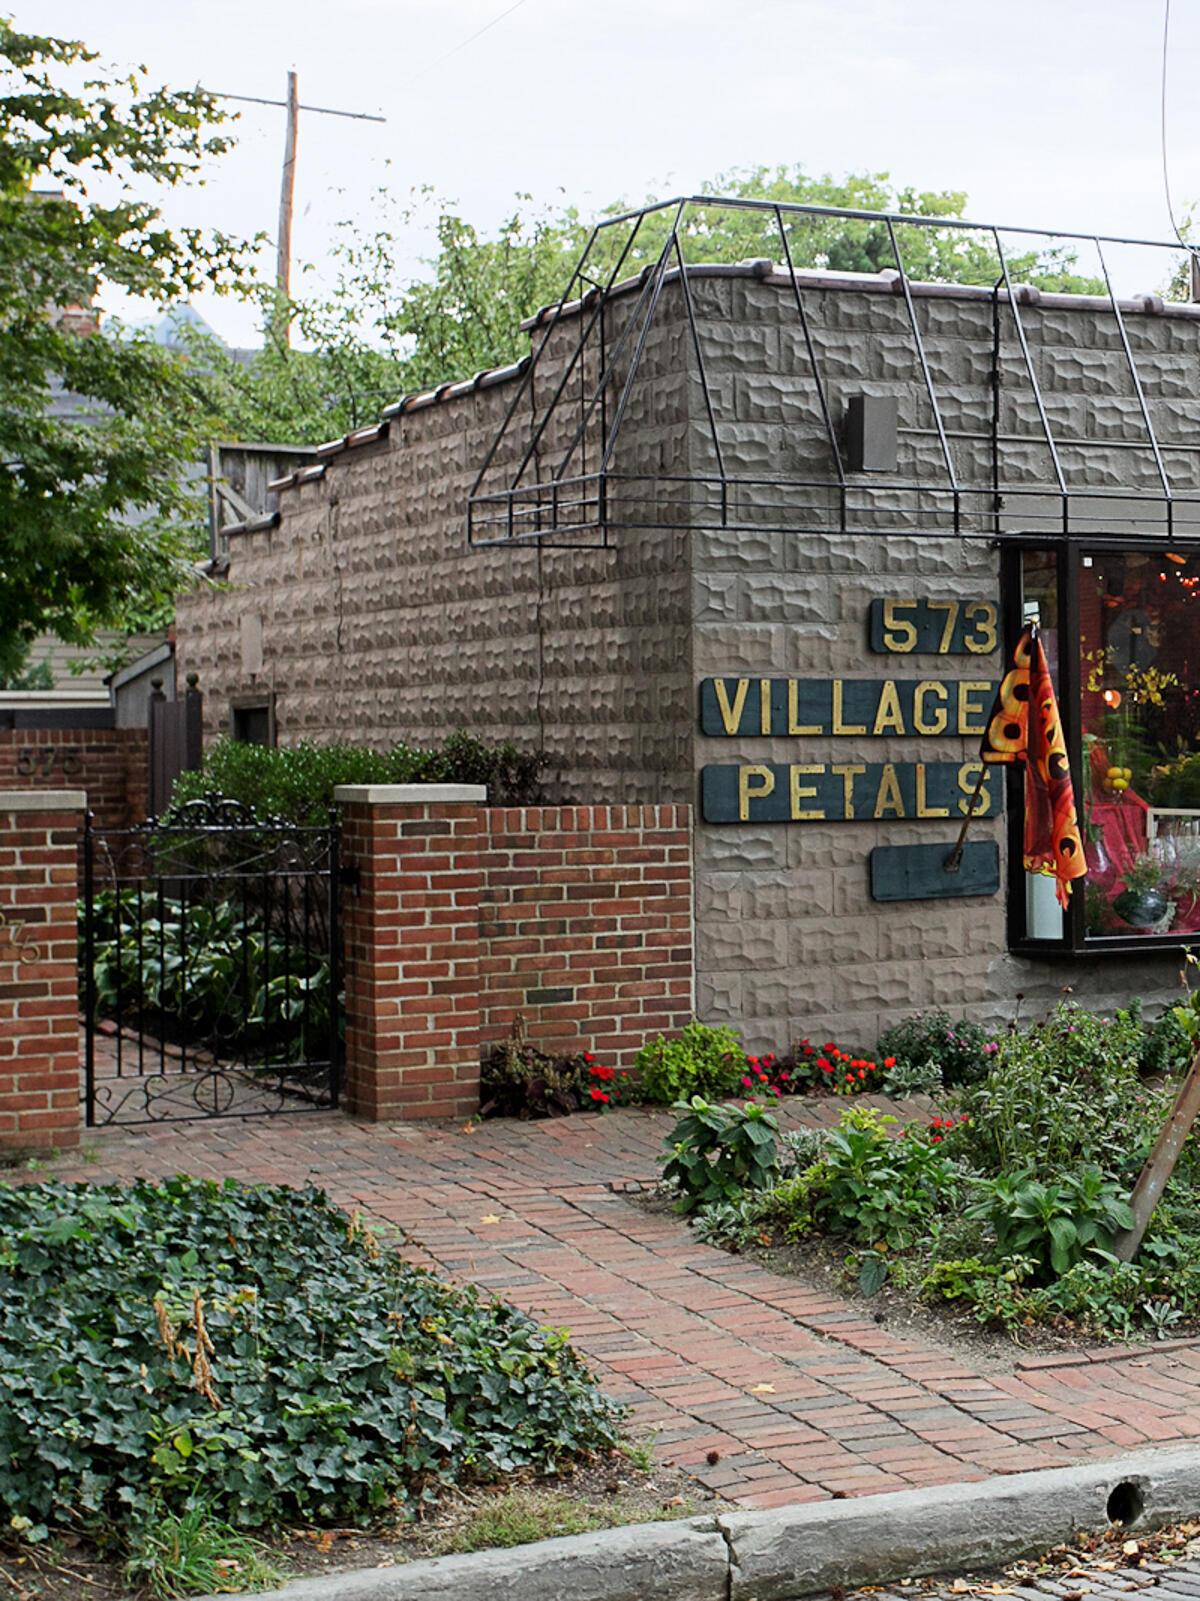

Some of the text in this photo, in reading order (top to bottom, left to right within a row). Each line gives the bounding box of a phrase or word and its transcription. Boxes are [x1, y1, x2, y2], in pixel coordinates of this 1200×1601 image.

[883, 599, 998, 653] 573
[713, 678, 992, 736] VILLAGE
[738, 763, 991, 821] PETALS
